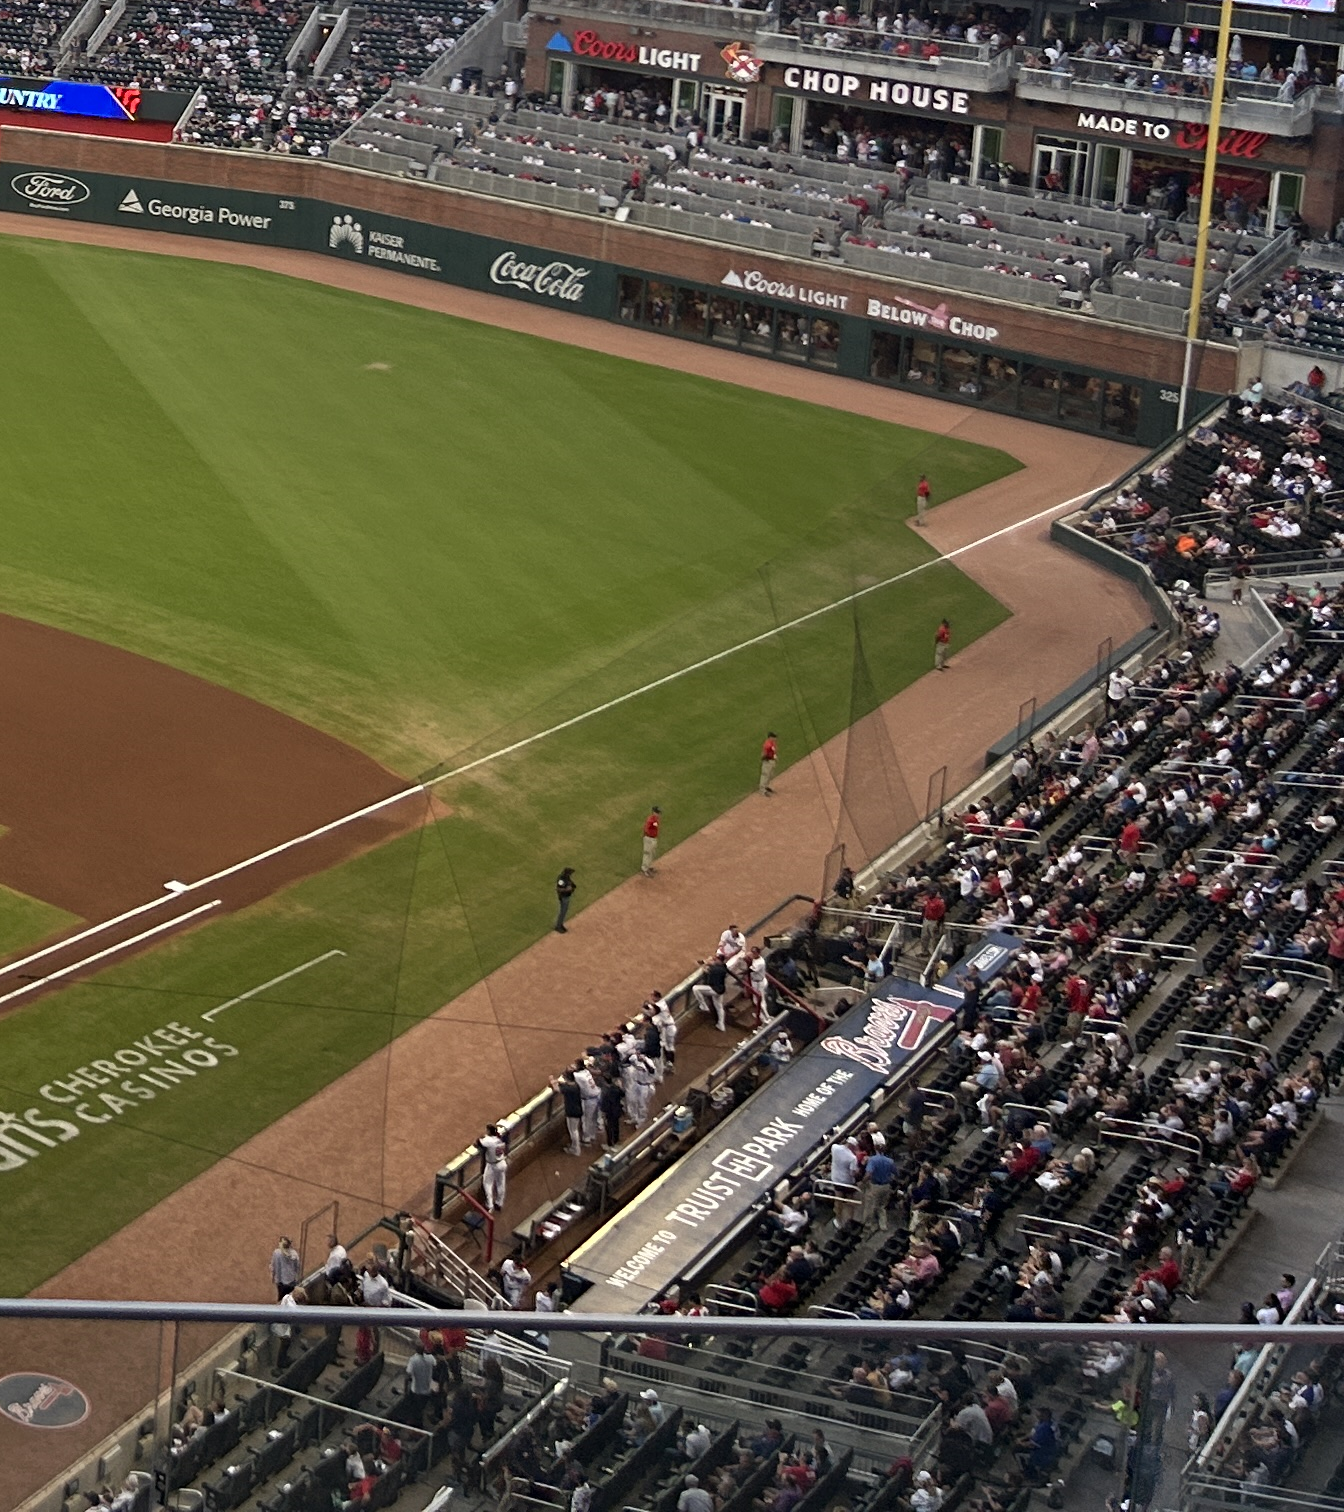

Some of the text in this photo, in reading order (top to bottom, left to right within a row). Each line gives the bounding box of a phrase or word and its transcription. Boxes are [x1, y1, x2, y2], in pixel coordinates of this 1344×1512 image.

[574, 30, 637, 62] Coors
[639, 46, 701, 72] LIGHT
[785, 66, 860, 97] CHOP
[868, 81, 969, 115] HOUSE
[1078, 112, 1136, 136] MADE
[1143, 122, 1171, 140] TO
[25, 176, 76, 201] Ford
[148, 199, 272, 229] Georgia Power
[368, 246, 438, 272] PERMANENTE
[369, 231, 404, 249] KAISER
[743, 270, 848, 310] Coors LIGHT
[867, 299, 928, 327] BELOW
[949, 317, 999, 342] CHOP
[1159, 390, 1180, 404] 325
[820, 995, 908, 1075] Braves
[39, 1021, 202, 1103] CHEROKEE
[76, 1037, 240, 1124] CASINOS
[605, 1068, 855, 1289] WELCOME TO TRUIST PARK HOME OF THE
